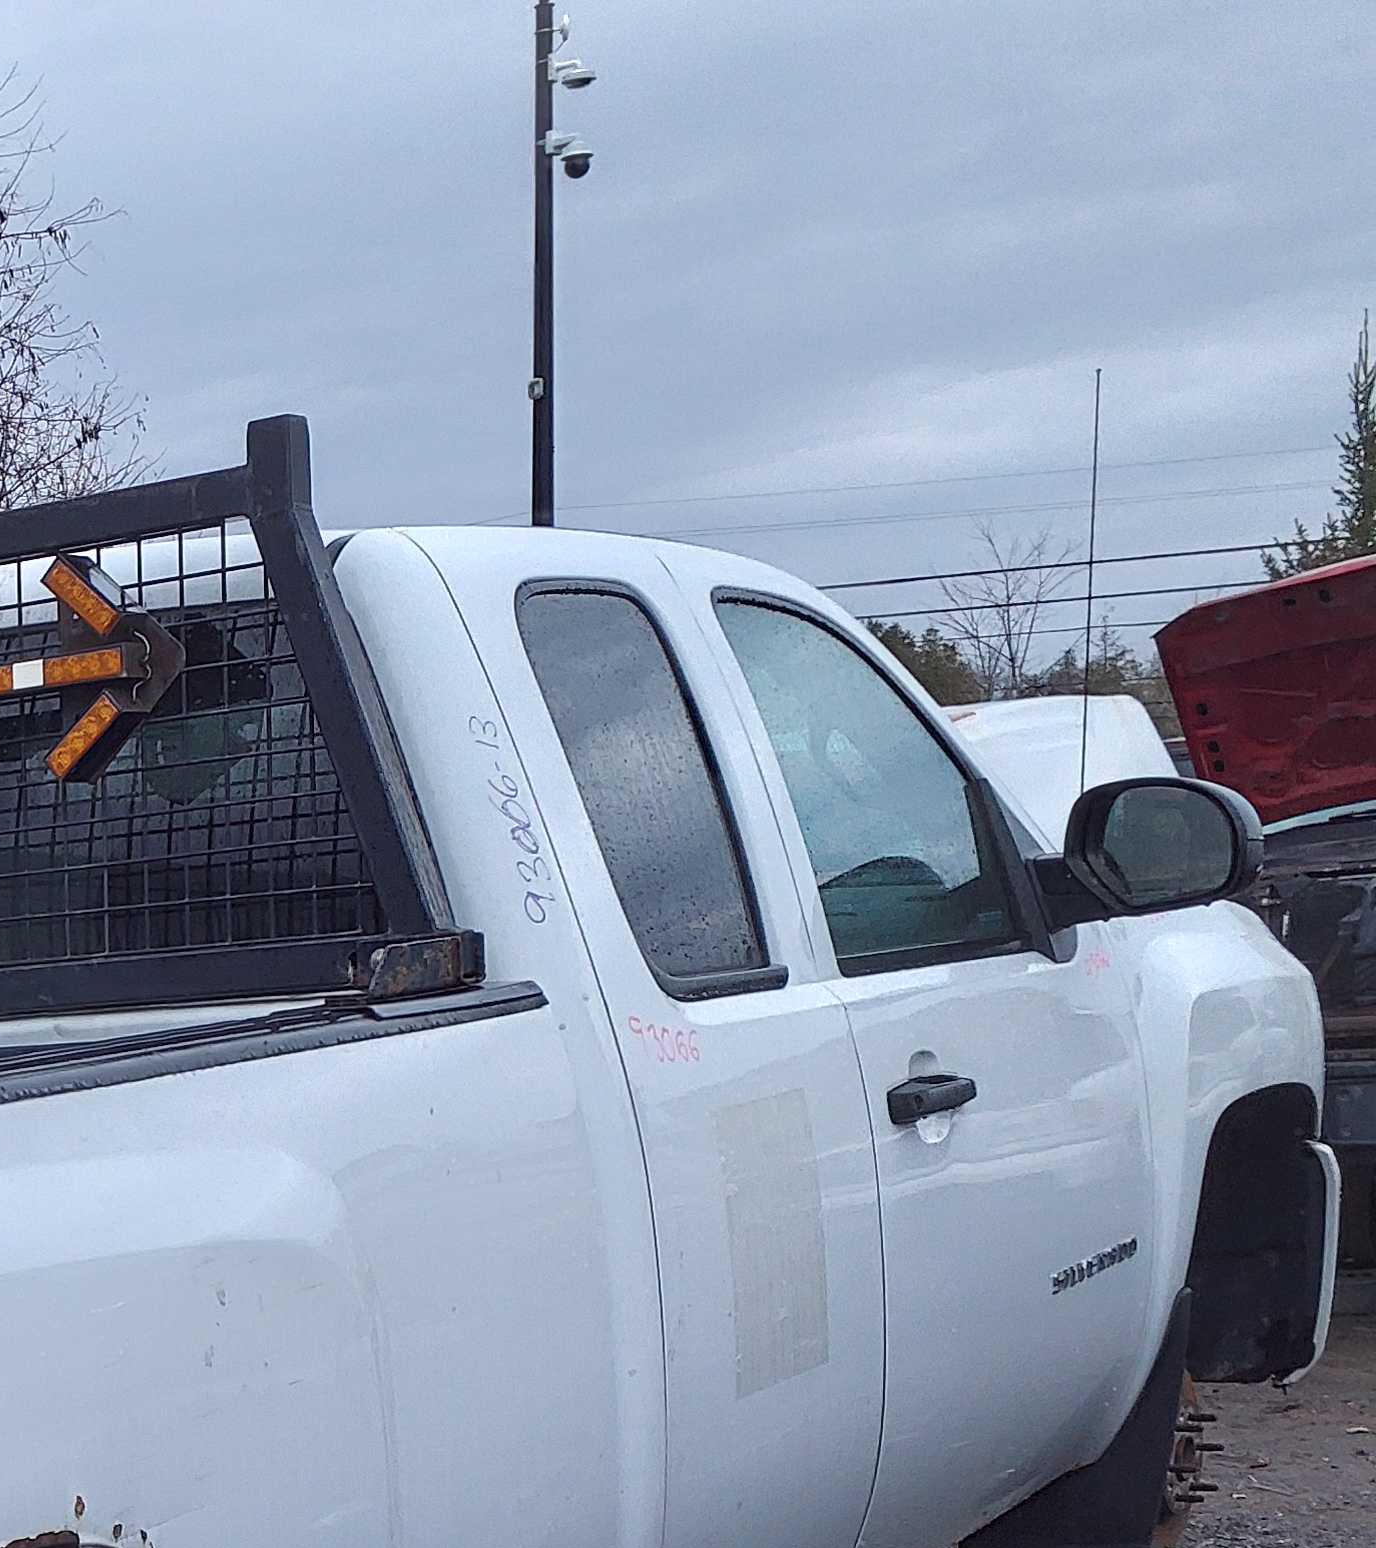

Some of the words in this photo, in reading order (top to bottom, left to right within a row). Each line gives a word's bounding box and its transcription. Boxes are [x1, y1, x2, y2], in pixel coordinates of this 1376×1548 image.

[468, 715, 555, 924] 93066-13
[628, 1016, 700, 1062] 93066
[1051, 1238, 1137, 1295] SILVERADO
